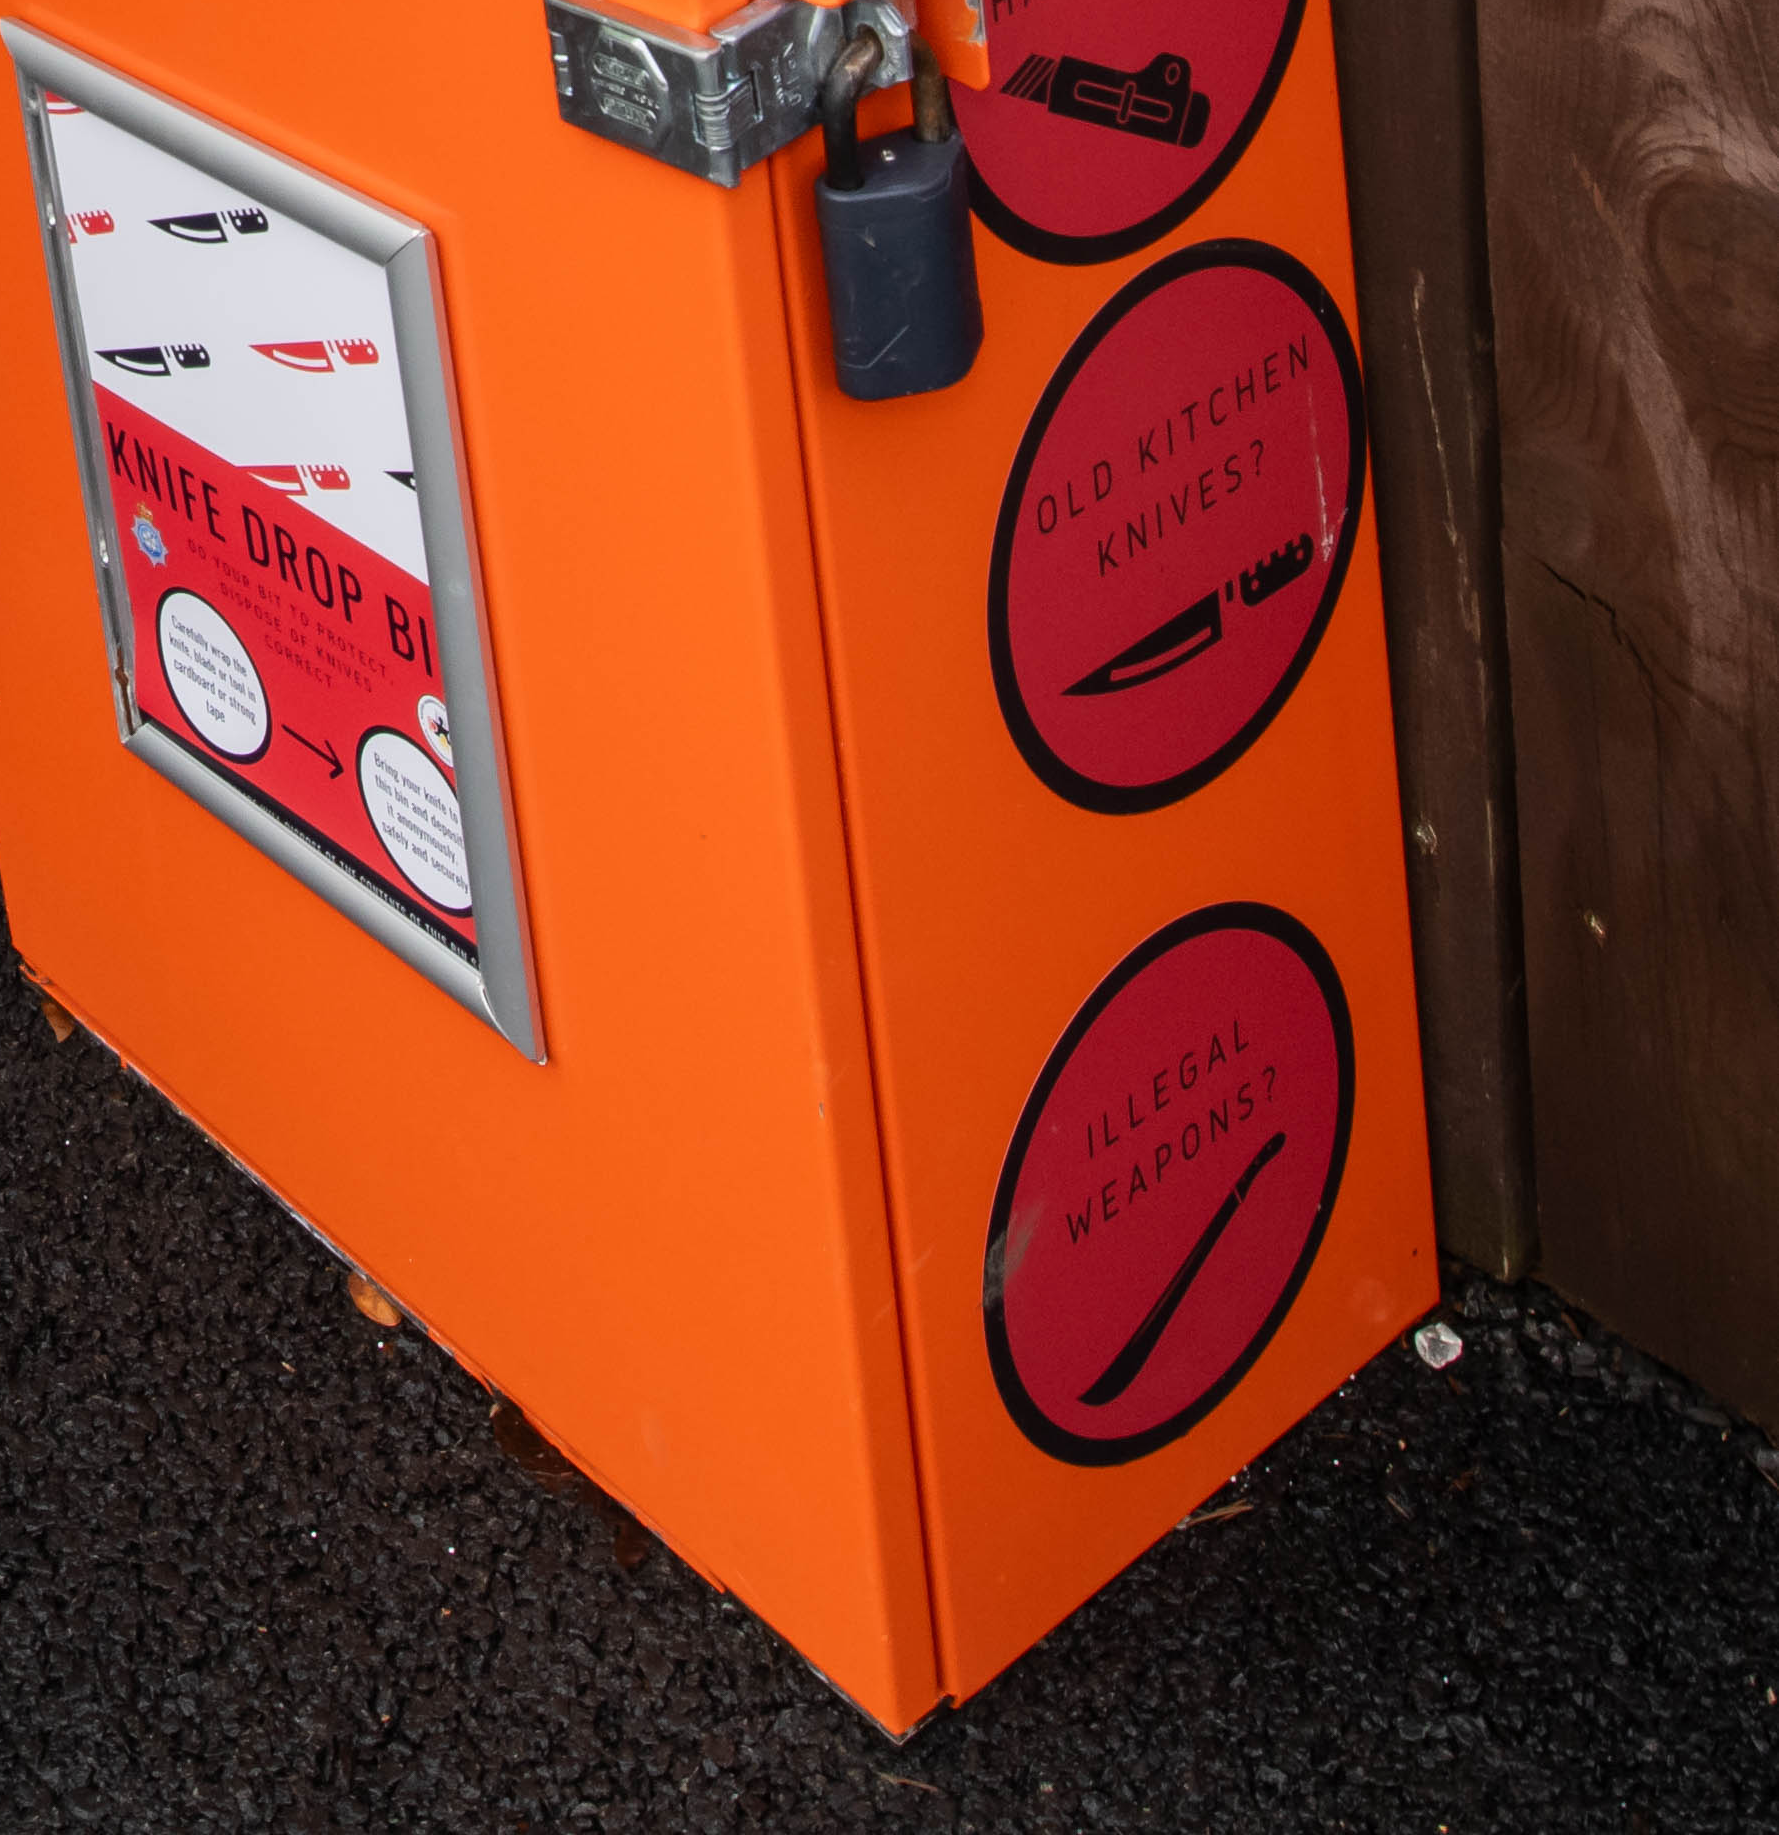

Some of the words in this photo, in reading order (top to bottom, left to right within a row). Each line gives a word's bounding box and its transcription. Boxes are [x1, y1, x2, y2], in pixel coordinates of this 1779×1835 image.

[1037, 460, 1112, 533] OLD
[1138, 334, 1308, 473] KITCHEN
[1097, 439, 1265, 577] KNIVES?
[106, 421, 226, 543] KNIFE
[241, 504, 363, 624] DROP
[384, 593, 433, 678] BI
[187, 538, 207, 560] DO
[213, 556, 250, 587] YOUR
[258, 584, 281, 605] BIT
[290, 604, 309, 627] TO
[171, 615, 209, 652] Carefully
[210, 644, 231, 668] wrap
[233, 657, 248, 677] the
[220, 582, 281, 634] DISPOSE
[290, 628, 306, 647] OF
[316, 646, 372, 694] KNIVES
[264, 634, 332, 688] CORRECT
[174, 659, 216, 695] cardboard
[218, 688, 228, 700] or
[229, 694, 256, 726] strong
[194, 648, 216, 675] blade
[219, 668, 227, 681] or
[229, 674, 246, 697] tool
[248, 686, 256, 704] in
[206, 698, 226, 723] tape
[373, 752, 400, 784] Bring
[401, 773, 422, 796] your
[424, 786, 447, 816] knife
[449, 805, 458, 825] to
[374, 773, 393, 798] this
[394, 785, 409, 807] bin
[411, 800, 429, 823] and
[386, 802, 394, 820] it
[381, 821, 409, 851] safely
[411, 842, 429, 864] and
[430, 853, 470, 896] securely
[1088, 1019, 1249, 1159] ILLEGAL
[1066, 1066, 1277, 1245] WEAPONS?
